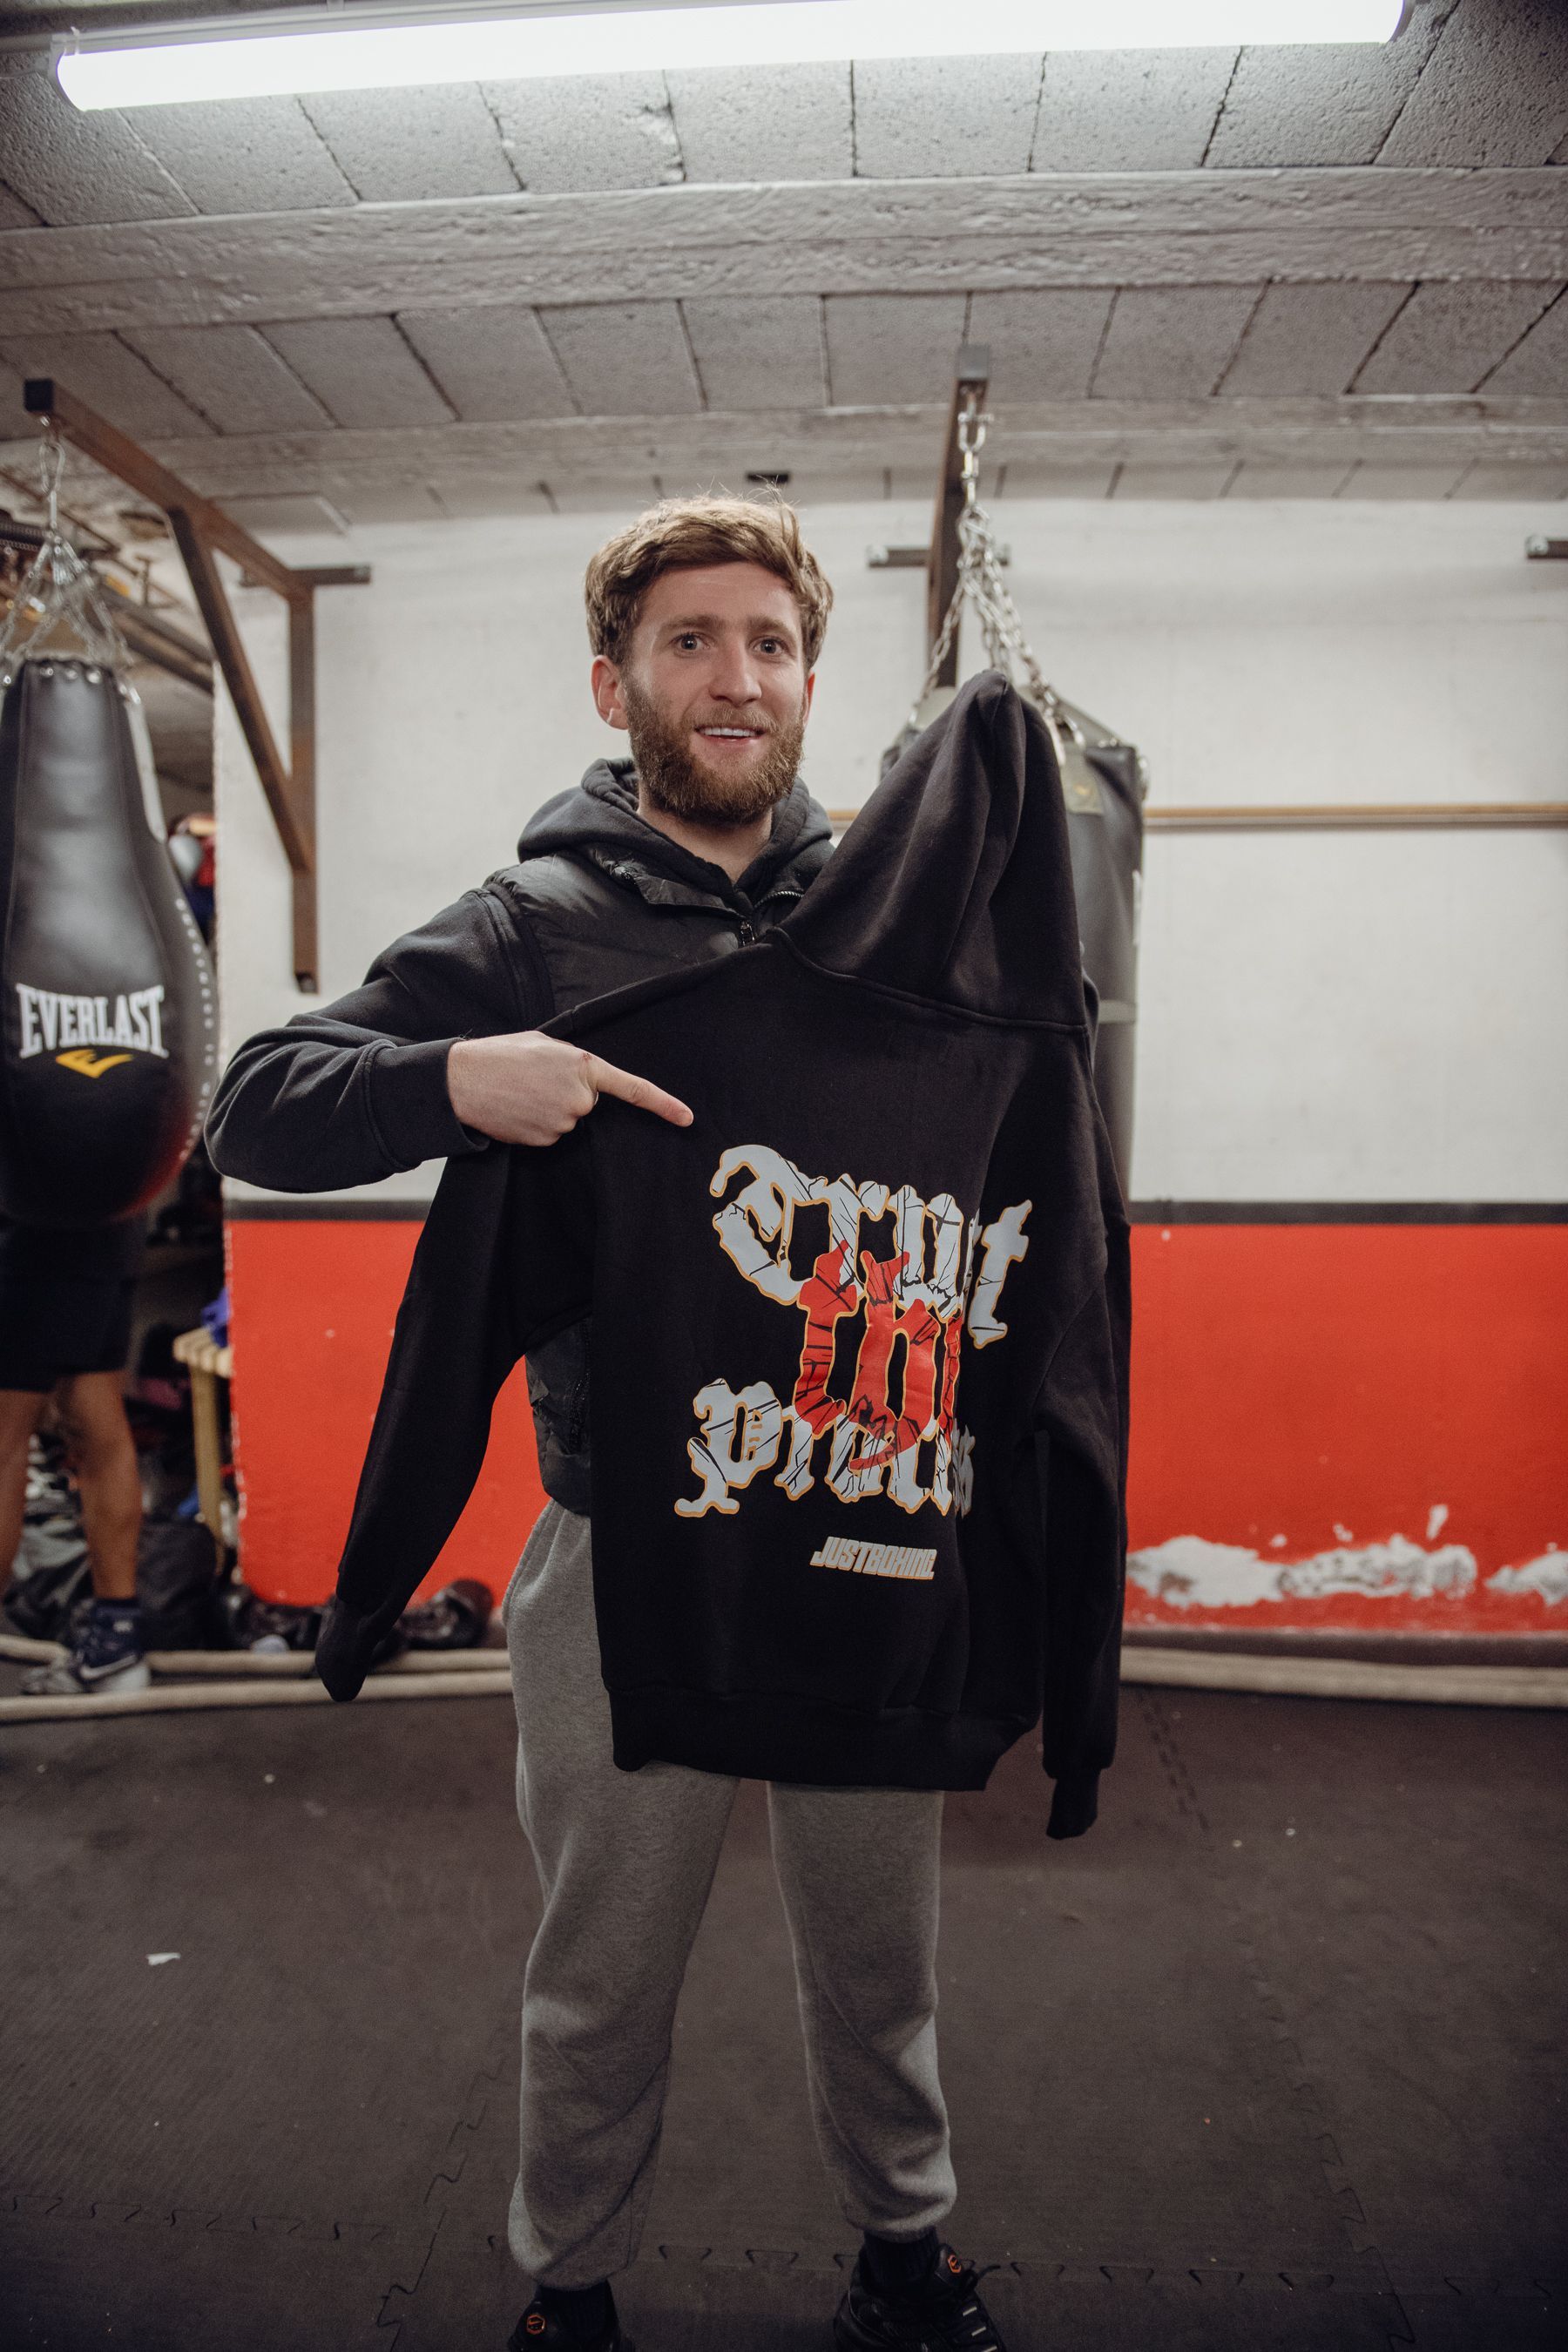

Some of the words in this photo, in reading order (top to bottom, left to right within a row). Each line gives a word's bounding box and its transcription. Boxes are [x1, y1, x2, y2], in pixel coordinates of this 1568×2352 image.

[15, 983, 170, 1058] EVERLAST
[709, 1144, 1032, 1349] Trut
[674, 1378, 975, 1518] proc
[809, 1536, 937, 1580] JUSTBOXING
